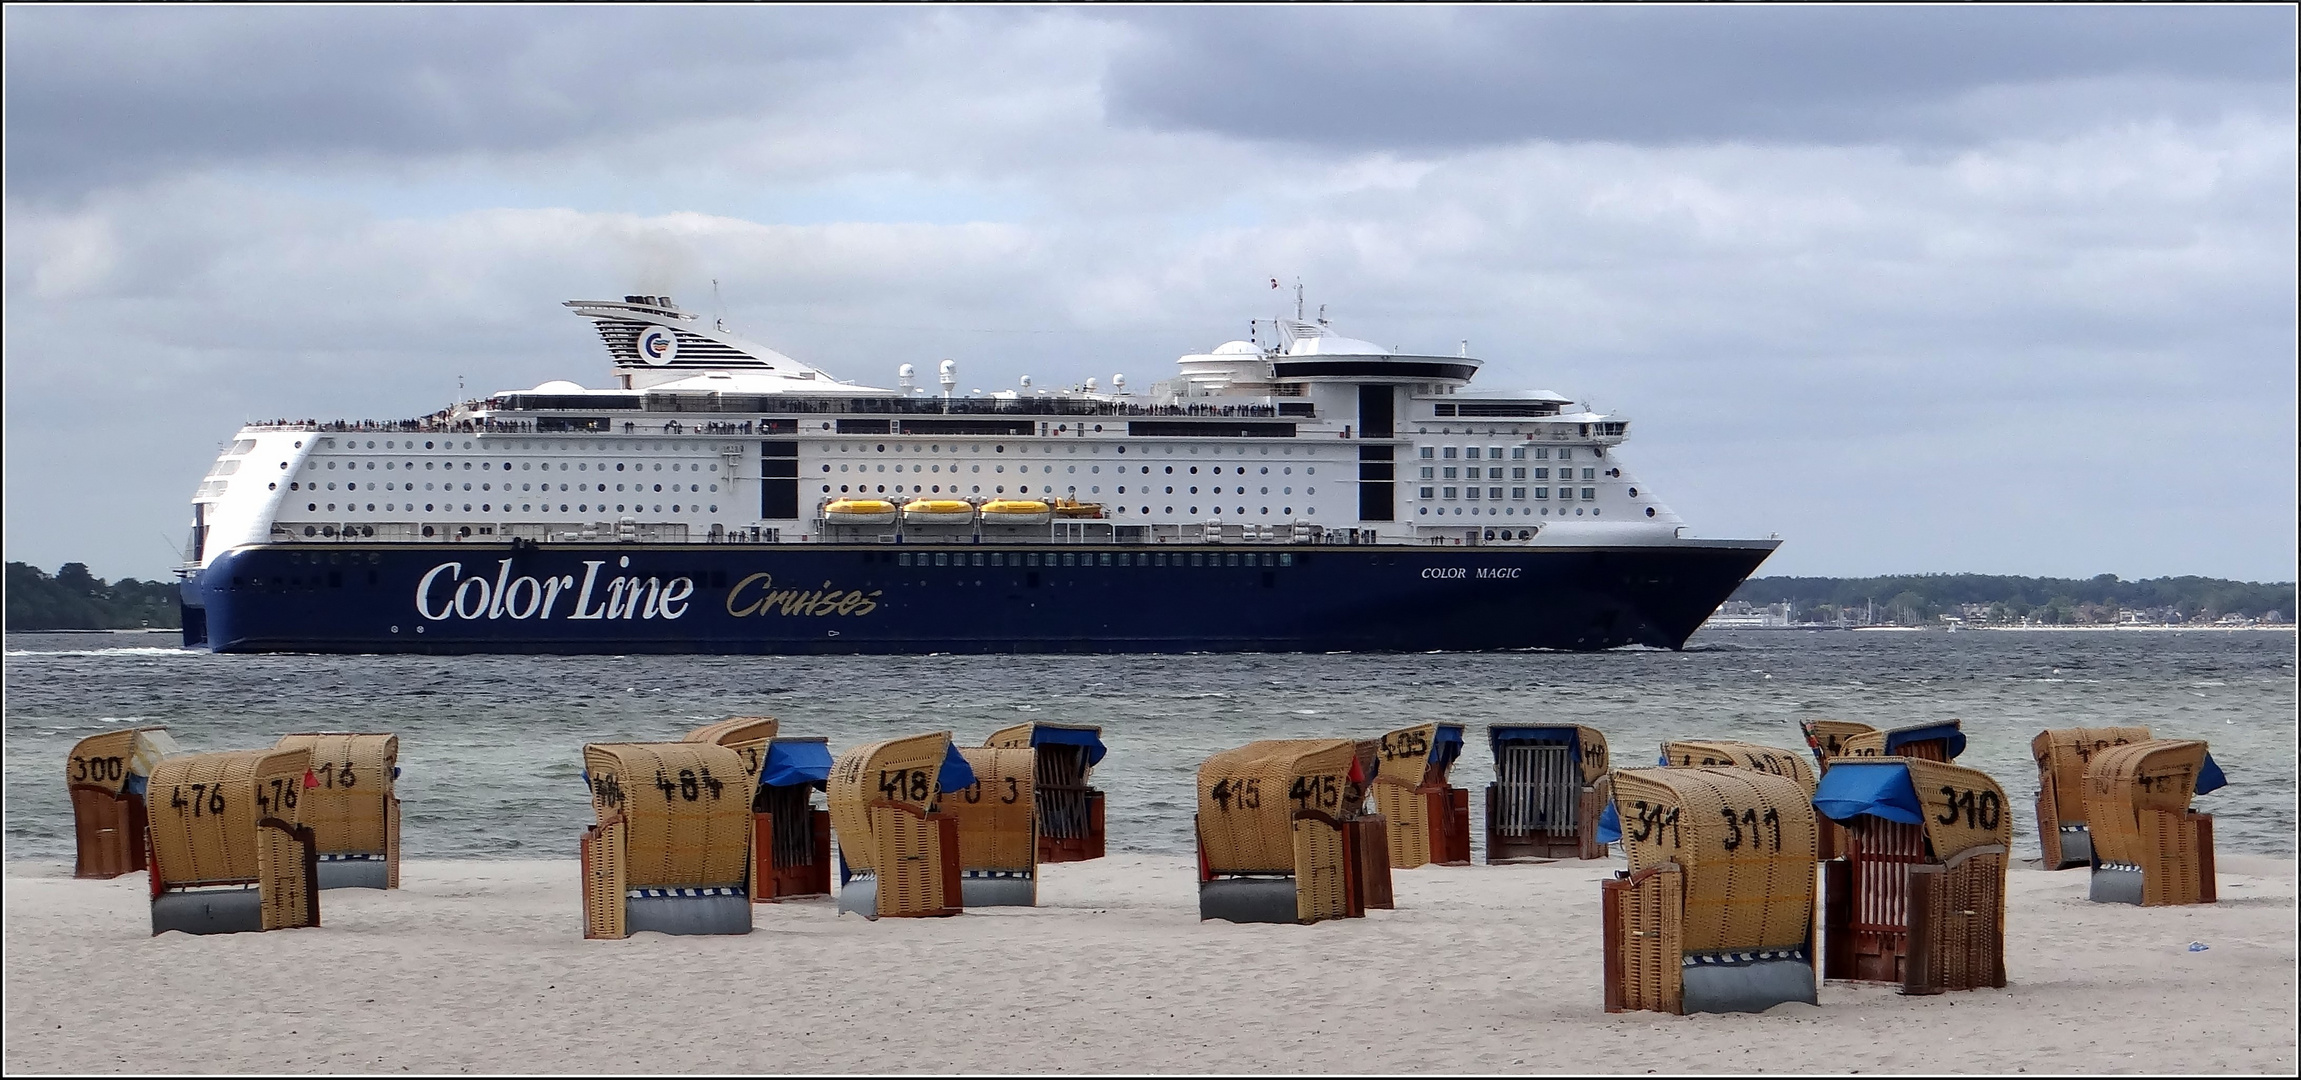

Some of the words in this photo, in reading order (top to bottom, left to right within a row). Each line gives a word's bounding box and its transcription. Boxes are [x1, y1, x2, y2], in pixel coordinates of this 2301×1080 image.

[1421, 568, 1466, 579] COLOR
[1475, 568, 1521, 579] MAGIC
[725, 572, 883, 618] Cruises
[73, 756, 124, 781] 300
[879, 769, 928, 801] 418
[172, 783, 225, 817] 476
[256, 778, 297, 814] 476
[1212, 778, 1260, 811] 415
[1289, 775, 1338, 808] 415
[1937, 786, 2000, 831] 310
[1633, 800, 1681, 849] 311
[1721, 807, 1781, 851] 311
